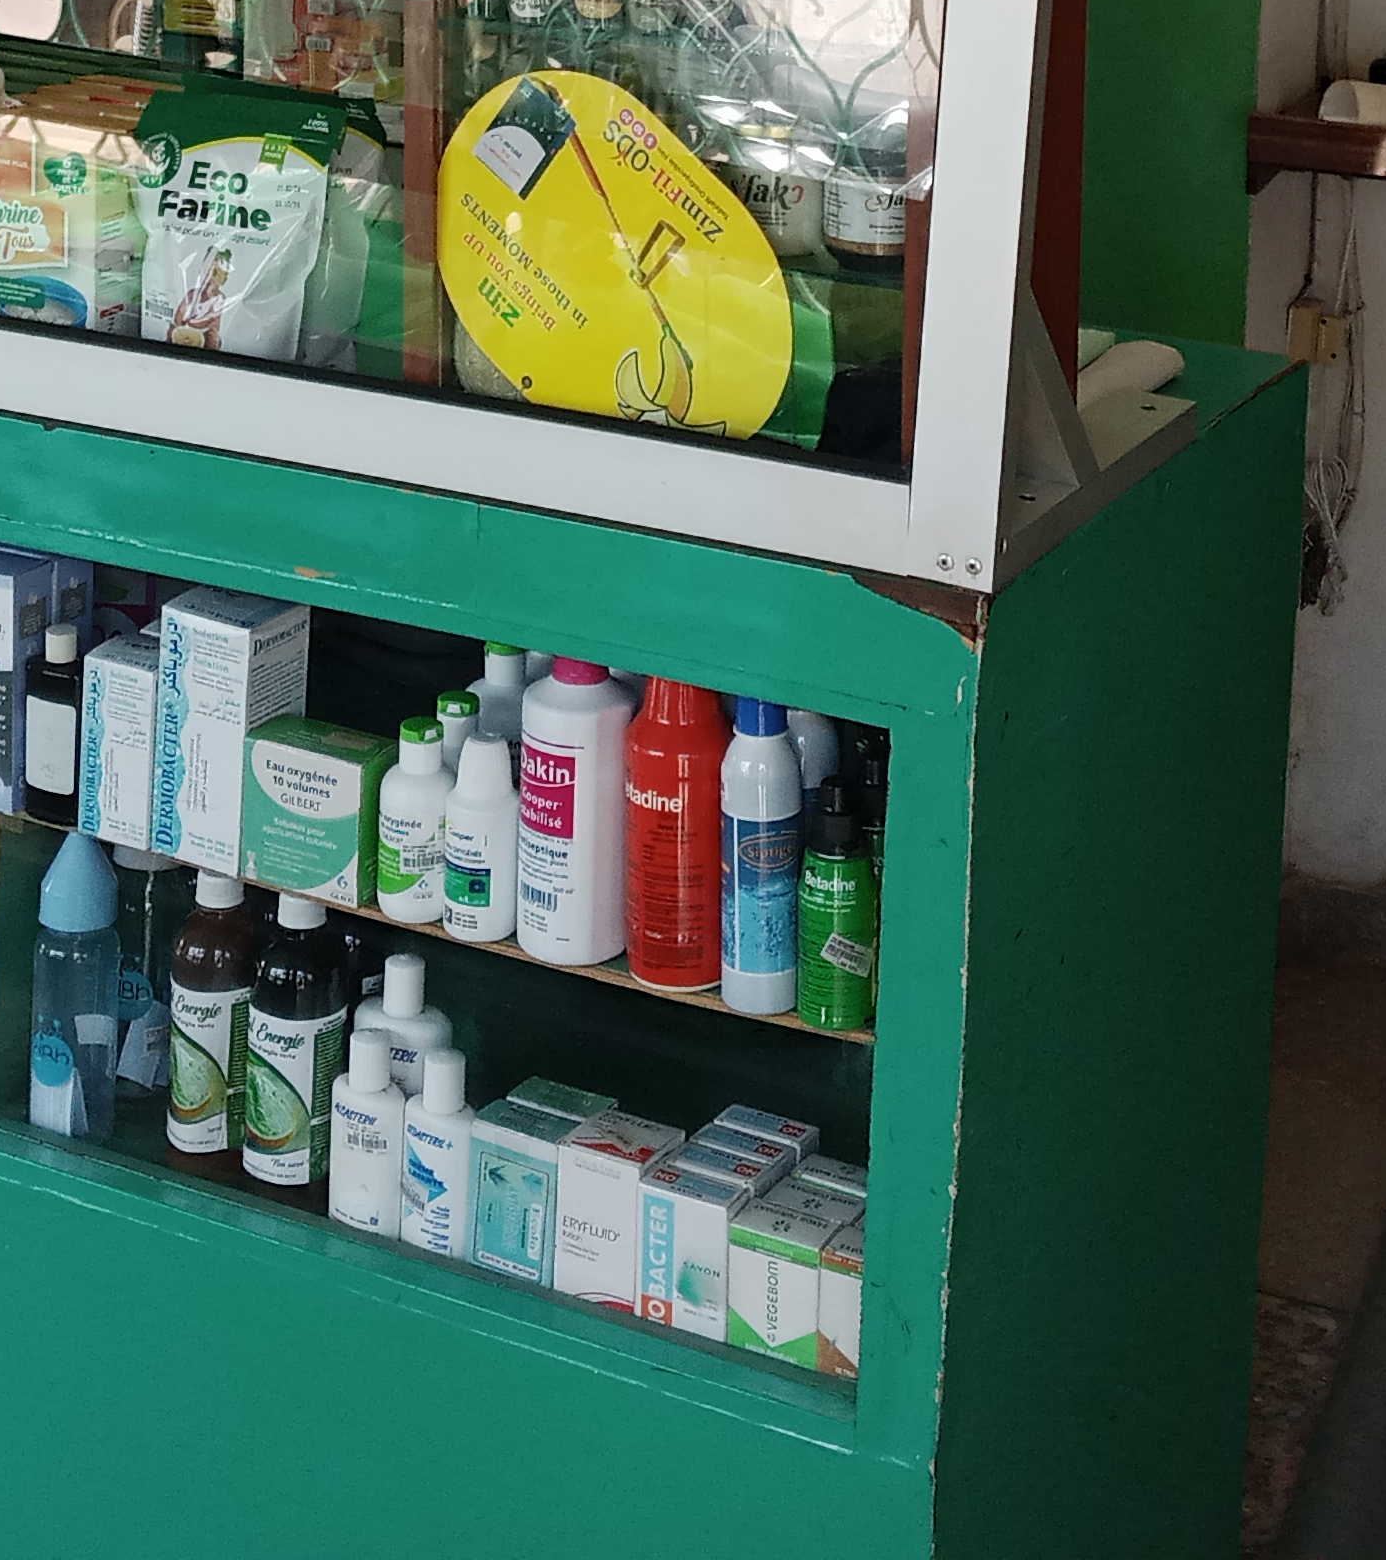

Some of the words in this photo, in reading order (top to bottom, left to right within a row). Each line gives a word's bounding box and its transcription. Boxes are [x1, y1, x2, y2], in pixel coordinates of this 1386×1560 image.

[187, 161, 249, 195] Eco
[158, 190, 272, 231] Farine
[460, 192, 534, 271] MOMENTS
[486, 251, 515, 283] you
[533, 268, 572, 310] those
[512, 279, 557, 332] Brings
[571, 308, 589, 331] in
[266, 759, 285, 773] Eau
[287, 766, 338, 788] oxygénée
[521, 748, 571, 785] Dakin
[273, 775, 284, 787] 10
[286, 780, 331, 799] volumes
[523, 786, 560, 811] Cooper
[448, 827, 475, 841] Cooper
[804, 870, 856, 891] Betadine
[175, 994, 222, 1022] Energie
[256, 1023, 306, 1051] Energie
[562, 1215, 621, 1242] ERYFLUID
[684, 1261, 721, 1278] SAVON
[766, 1260, 780, 1331] VEGEBOM
